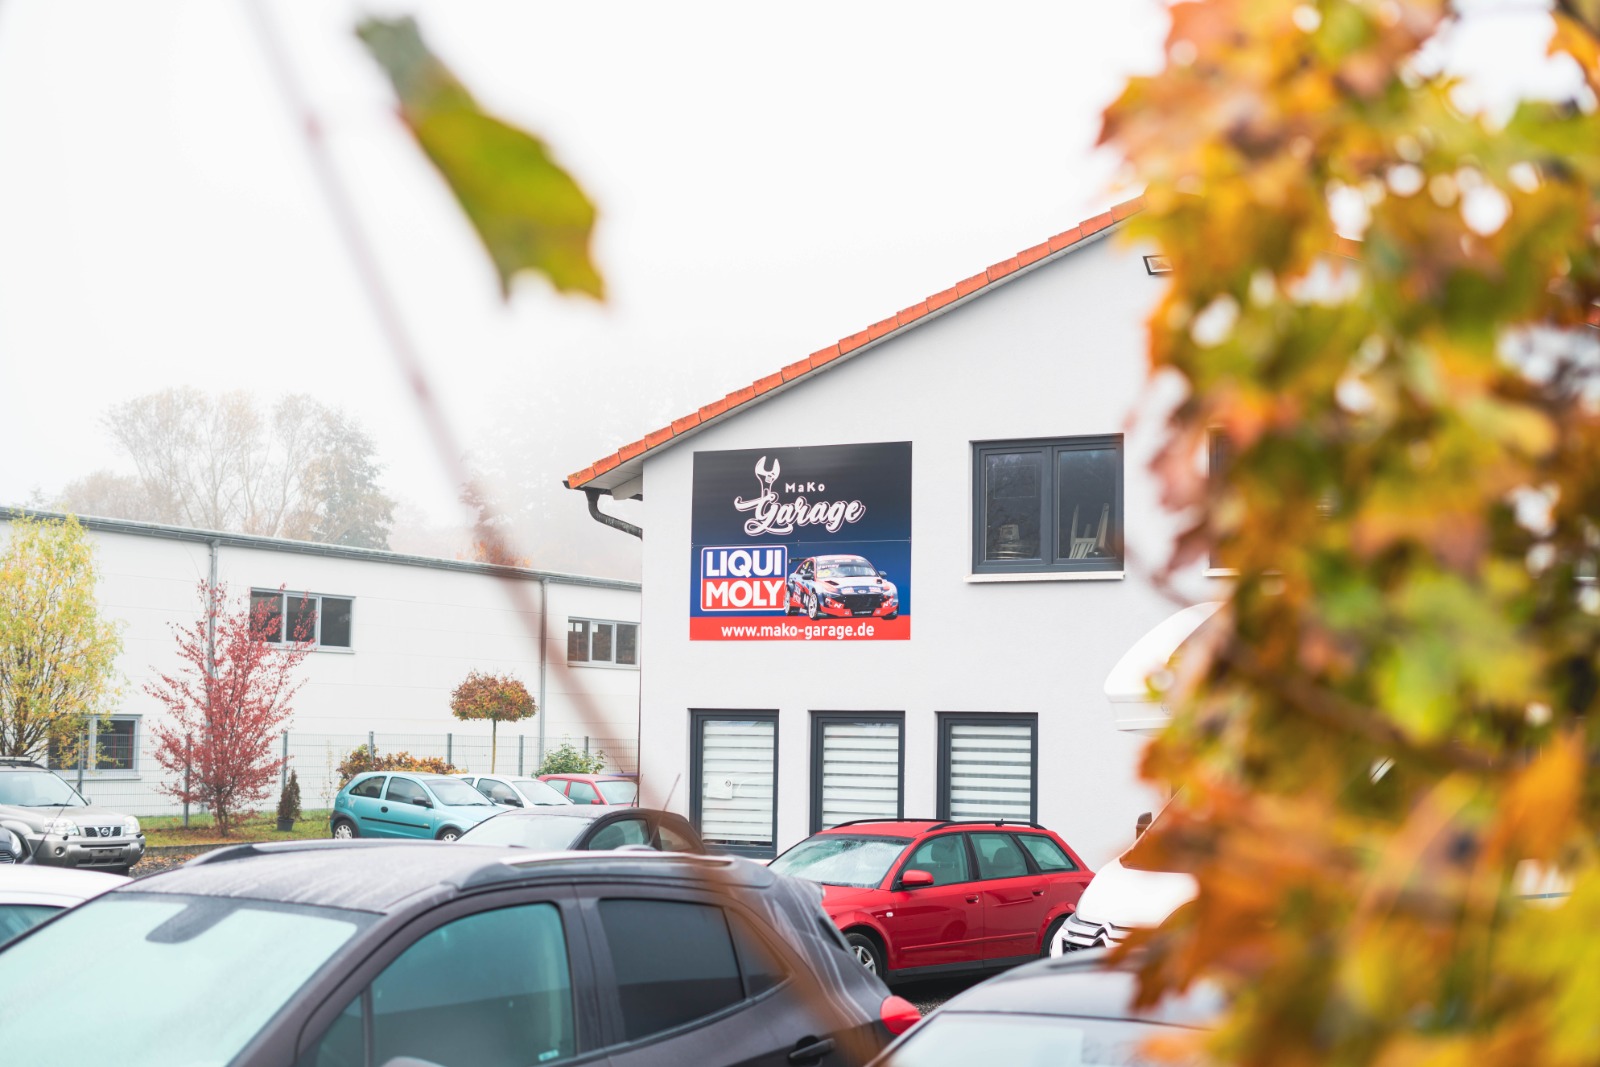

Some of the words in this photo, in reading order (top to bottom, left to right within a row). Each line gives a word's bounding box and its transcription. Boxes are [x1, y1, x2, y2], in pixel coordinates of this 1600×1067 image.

[785, 482, 825, 493] MaKo
[734, 491, 866, 536] Garage
[706, 549, 782, 578] LIQUI
[706, 580, 785, 607] MOLY
[721, 623, 874, 640] www.mako-garage.de
